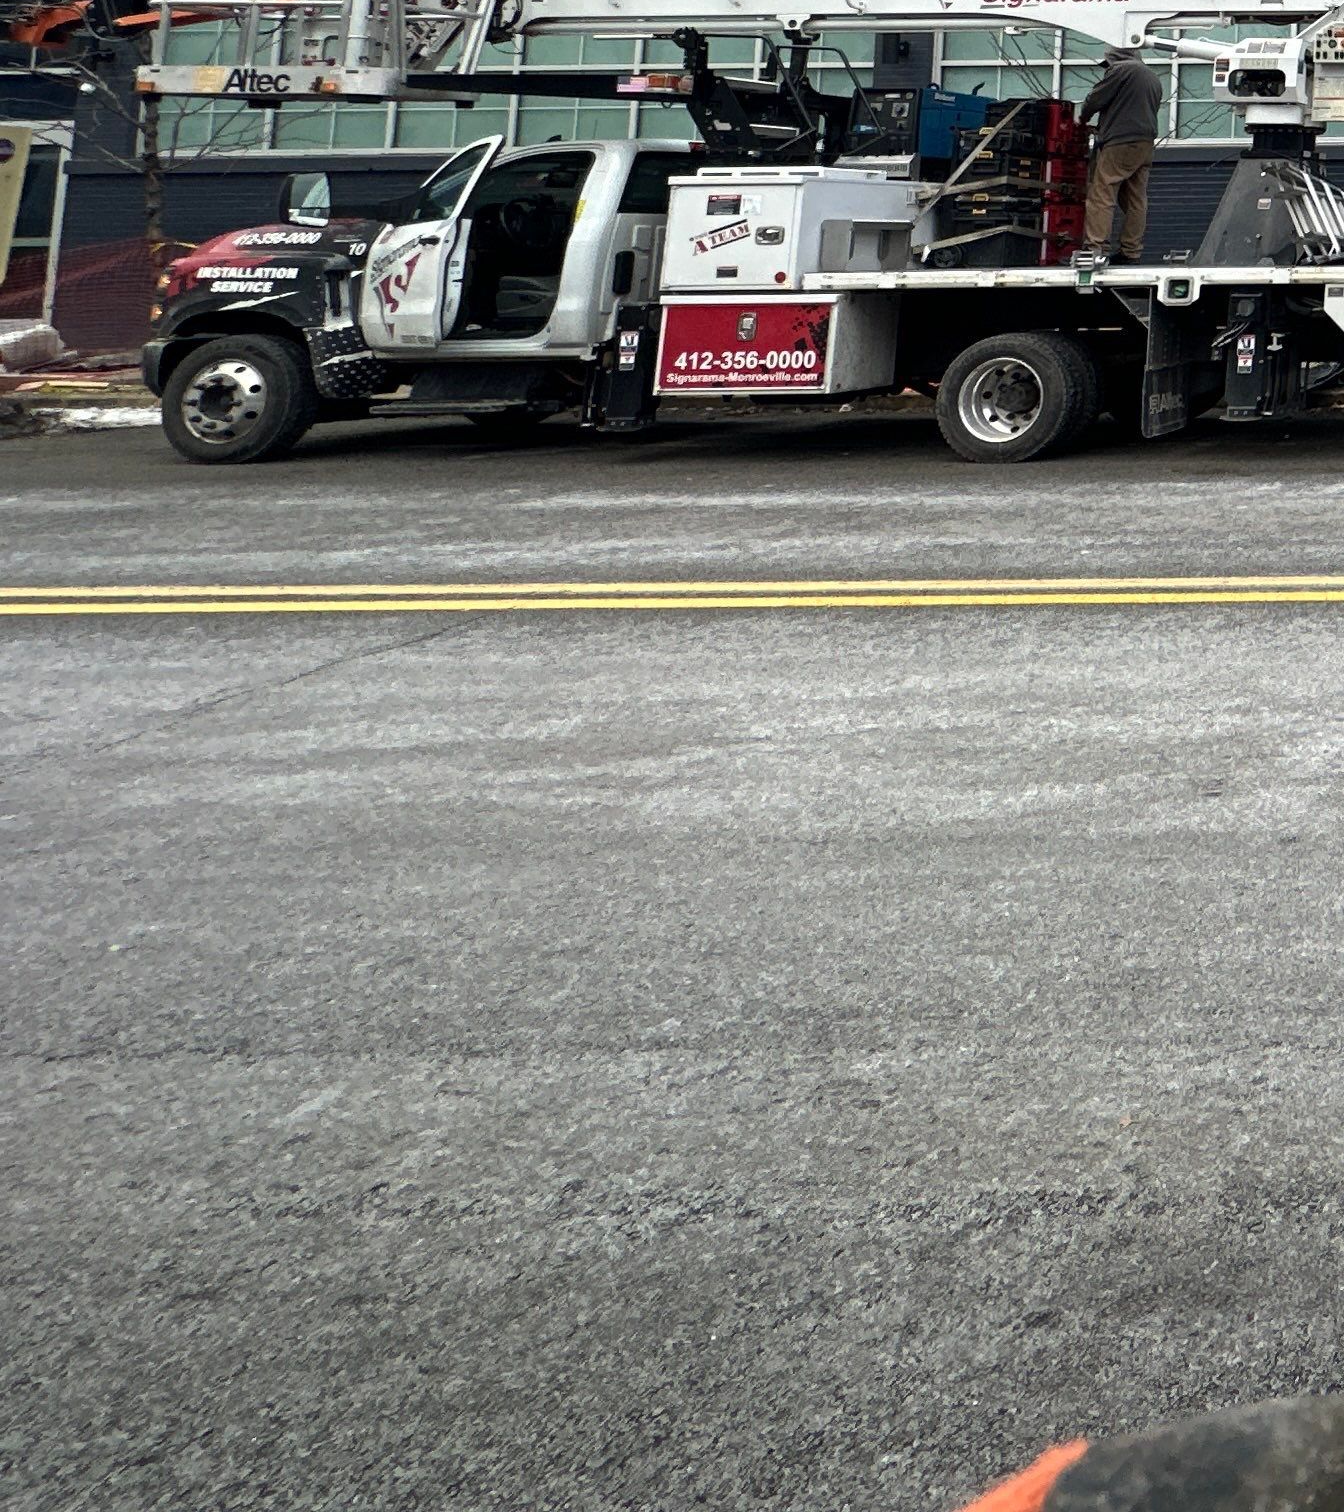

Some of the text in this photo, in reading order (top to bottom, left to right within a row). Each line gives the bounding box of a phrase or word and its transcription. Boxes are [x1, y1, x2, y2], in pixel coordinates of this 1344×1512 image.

[222, 68, 291, 93] Altec
[692, 223, 750, 256] A TEAM
[348, 242, 367, 256] 10
[196, 267, 299, 279] INSTALLATION
[210, 281, 274, 293] SERVICE
[674, 350, 817, 371] 412-356-0000
[666, 372, 818, 385] Signarama-Monroeville.com
